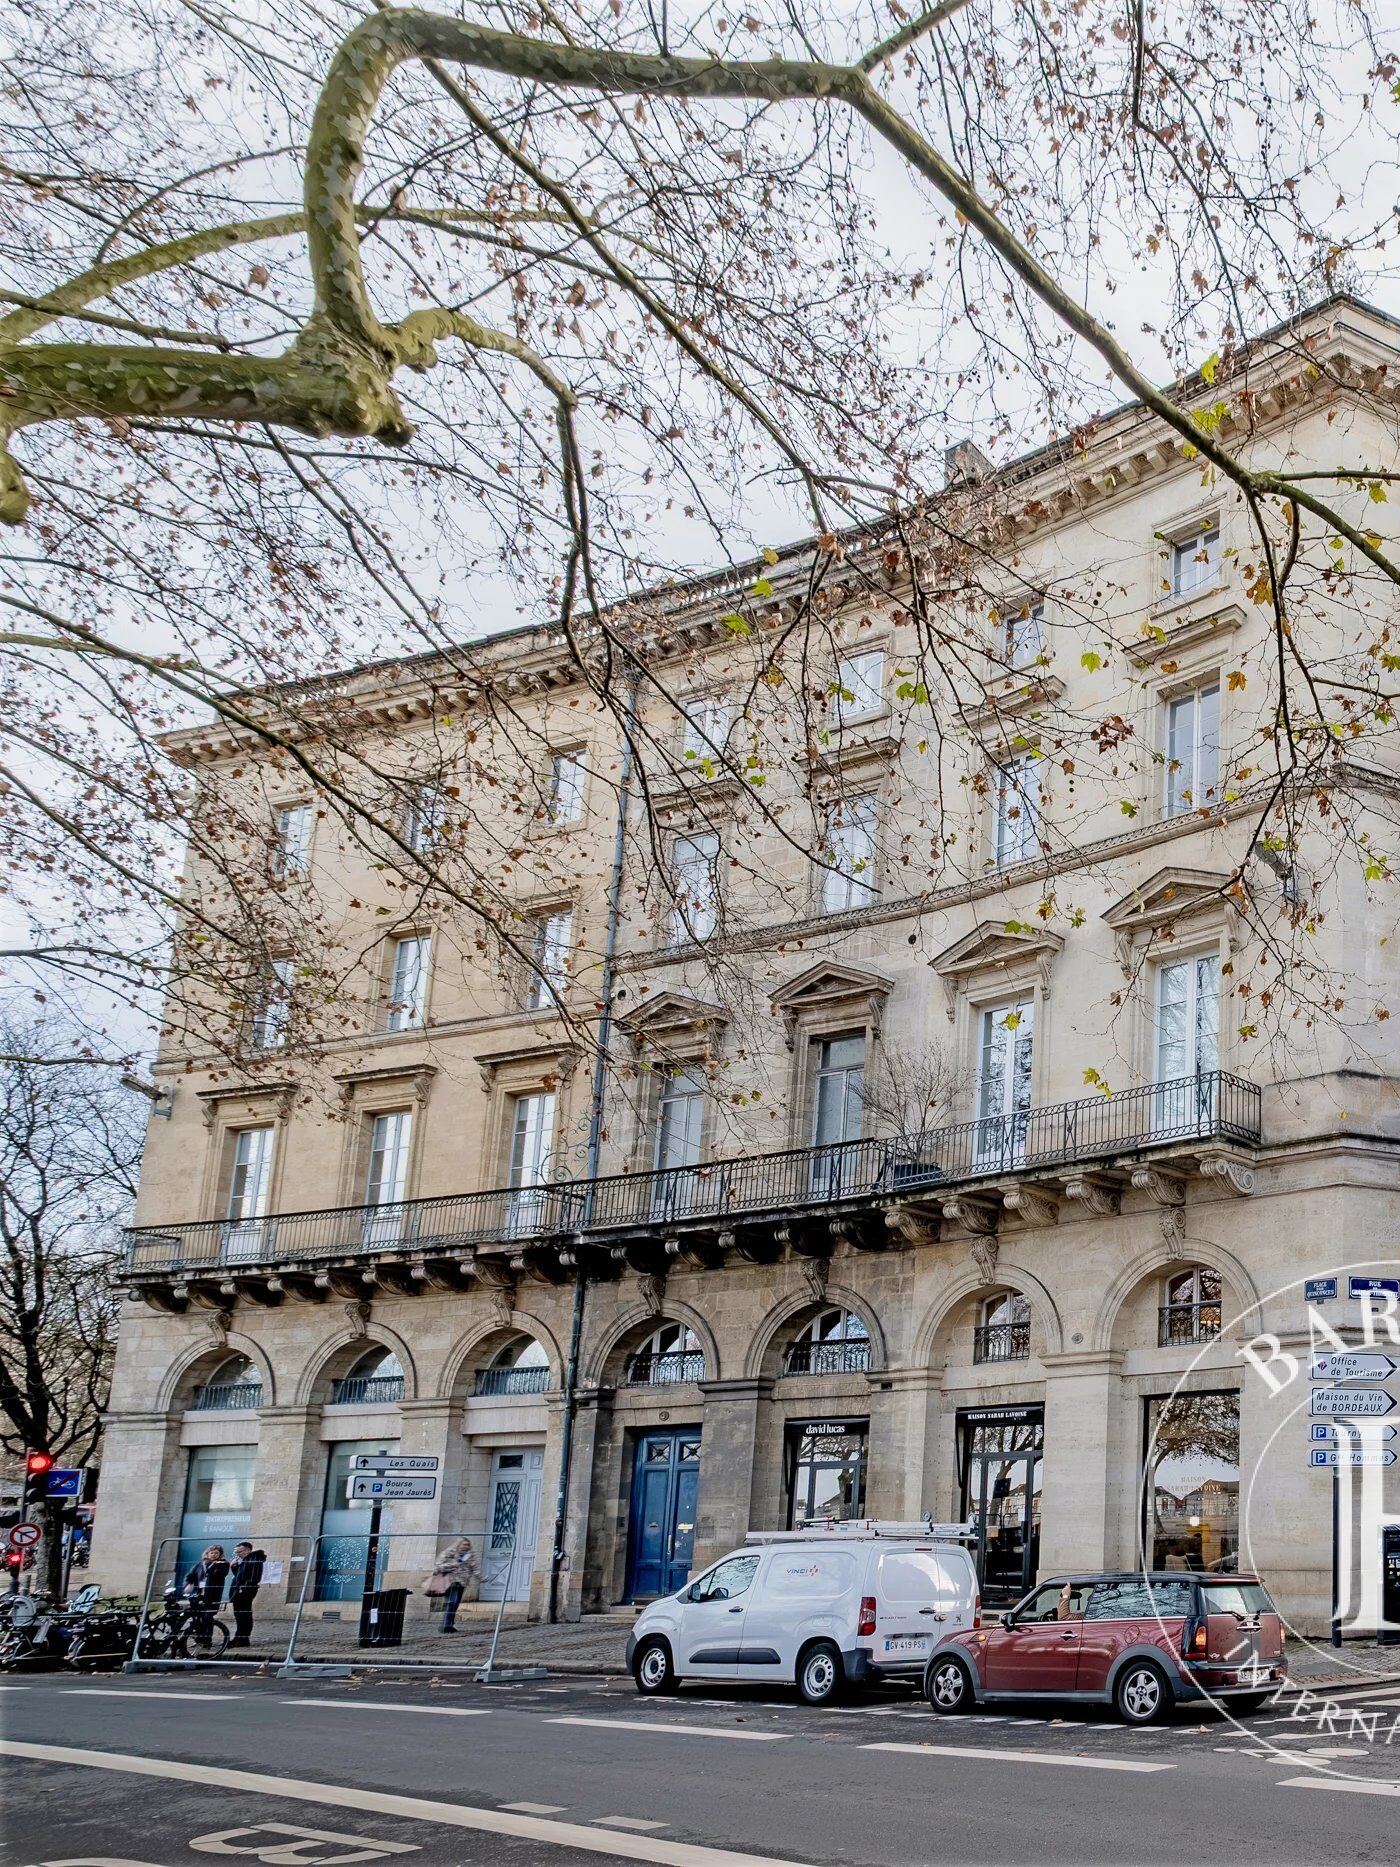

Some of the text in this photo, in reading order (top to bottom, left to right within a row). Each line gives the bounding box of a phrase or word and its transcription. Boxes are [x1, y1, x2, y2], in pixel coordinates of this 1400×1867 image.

[1330, 1357, 1357, 1366] Office
[1346, 1368, 1383, 1377] Tourisme
[1317, 1393, 1383, 1401] Maison du Vin
[1317, 1403, 1383, 1412] de BORDEAUX
[806, 1424, 845, 1434] david lucas
